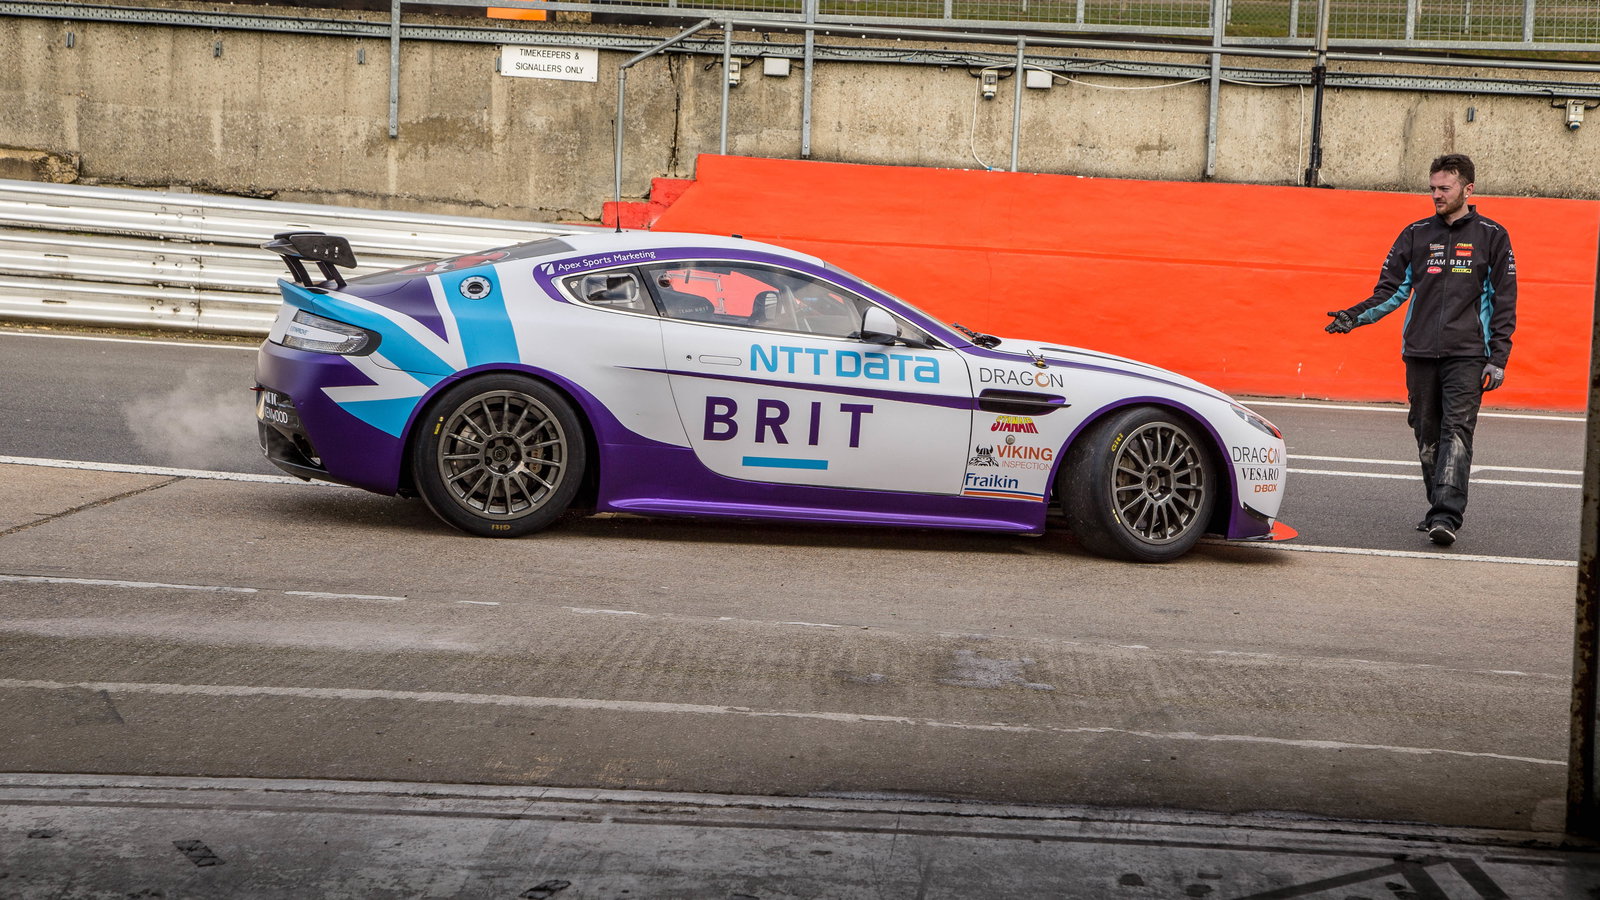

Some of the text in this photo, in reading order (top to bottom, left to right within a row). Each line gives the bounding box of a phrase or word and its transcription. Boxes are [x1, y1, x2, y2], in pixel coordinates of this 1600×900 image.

[519, 48, 580, 60] TIMEKEEPERS &
[515, 62, 584, 74] SIGNALLERS ONLY
[558, 250, 656, 271] Apex Sports Marketing
[1449, 259, 1473, 267] BRIT
[750, 344, 828, 376] NTT
[979, 367, 1064, 388] DRAGON
[703, 396, 874, 448] BRIT
[996, 444, 1053, 461] VIKING
[1232, 446, 1280, 465] DRAGON
[1001, 460, 1052, 471] INSPECTION
[1241, 467, 1280, 481] VESARO
[965, 472, 1019, 489] Fraikin
